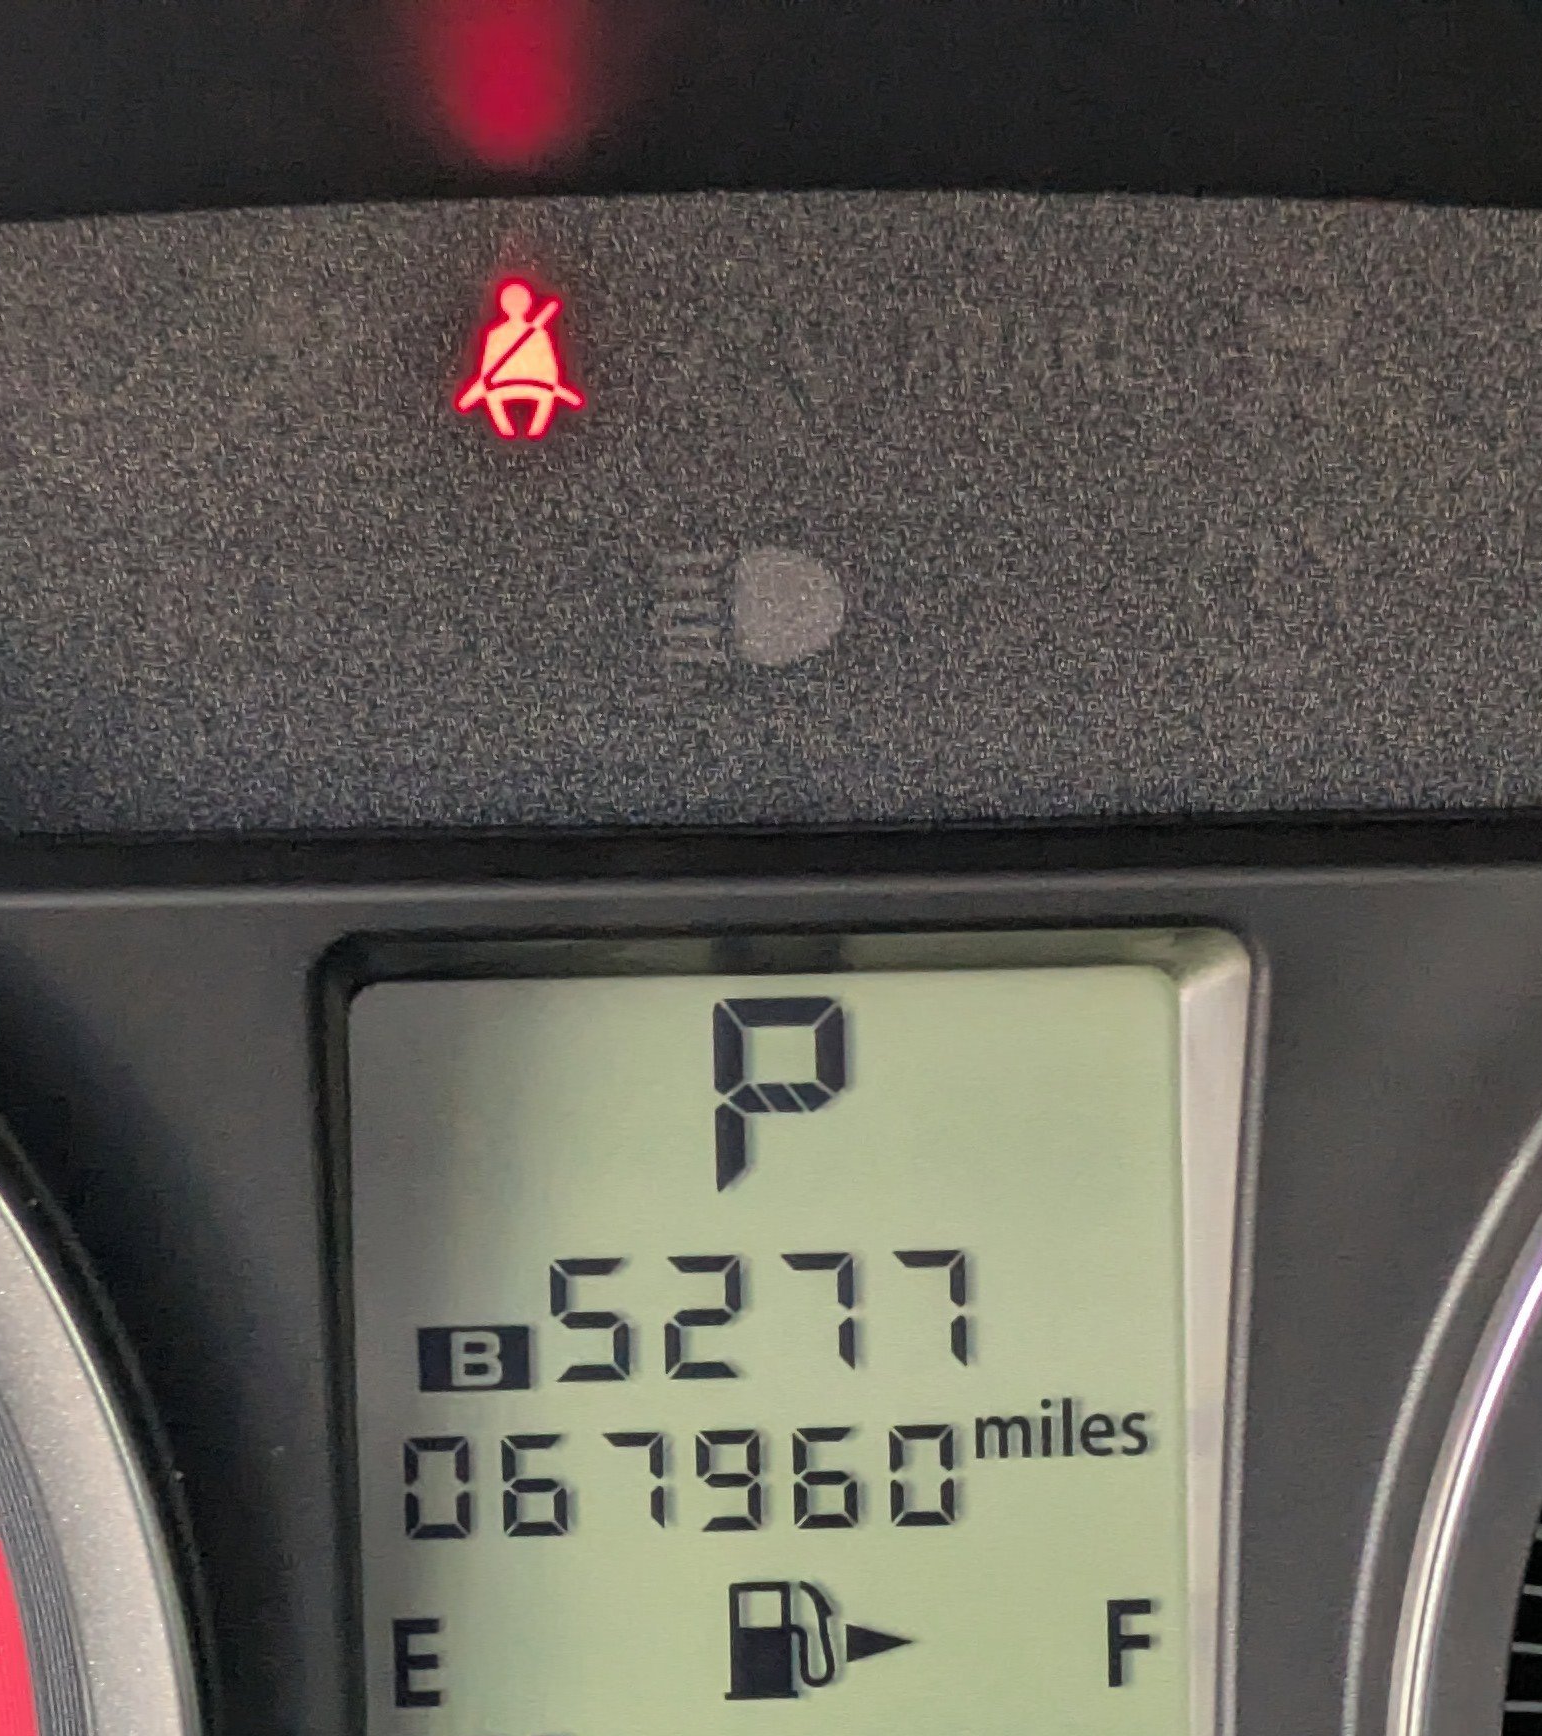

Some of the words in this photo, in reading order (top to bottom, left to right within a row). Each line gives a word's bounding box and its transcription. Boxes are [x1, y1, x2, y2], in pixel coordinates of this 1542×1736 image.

[712, 995, 849, 1192] P
[450, 1328, 504, 1386] B
[548, 1249, 971, 1383] 5277
[403, 1423, 955, 1540] 067960
[975, 1397, 1149, 1459] miles
[390, 1617, 441, 1709] E
[1106, 1598, 1154, 1688] F
